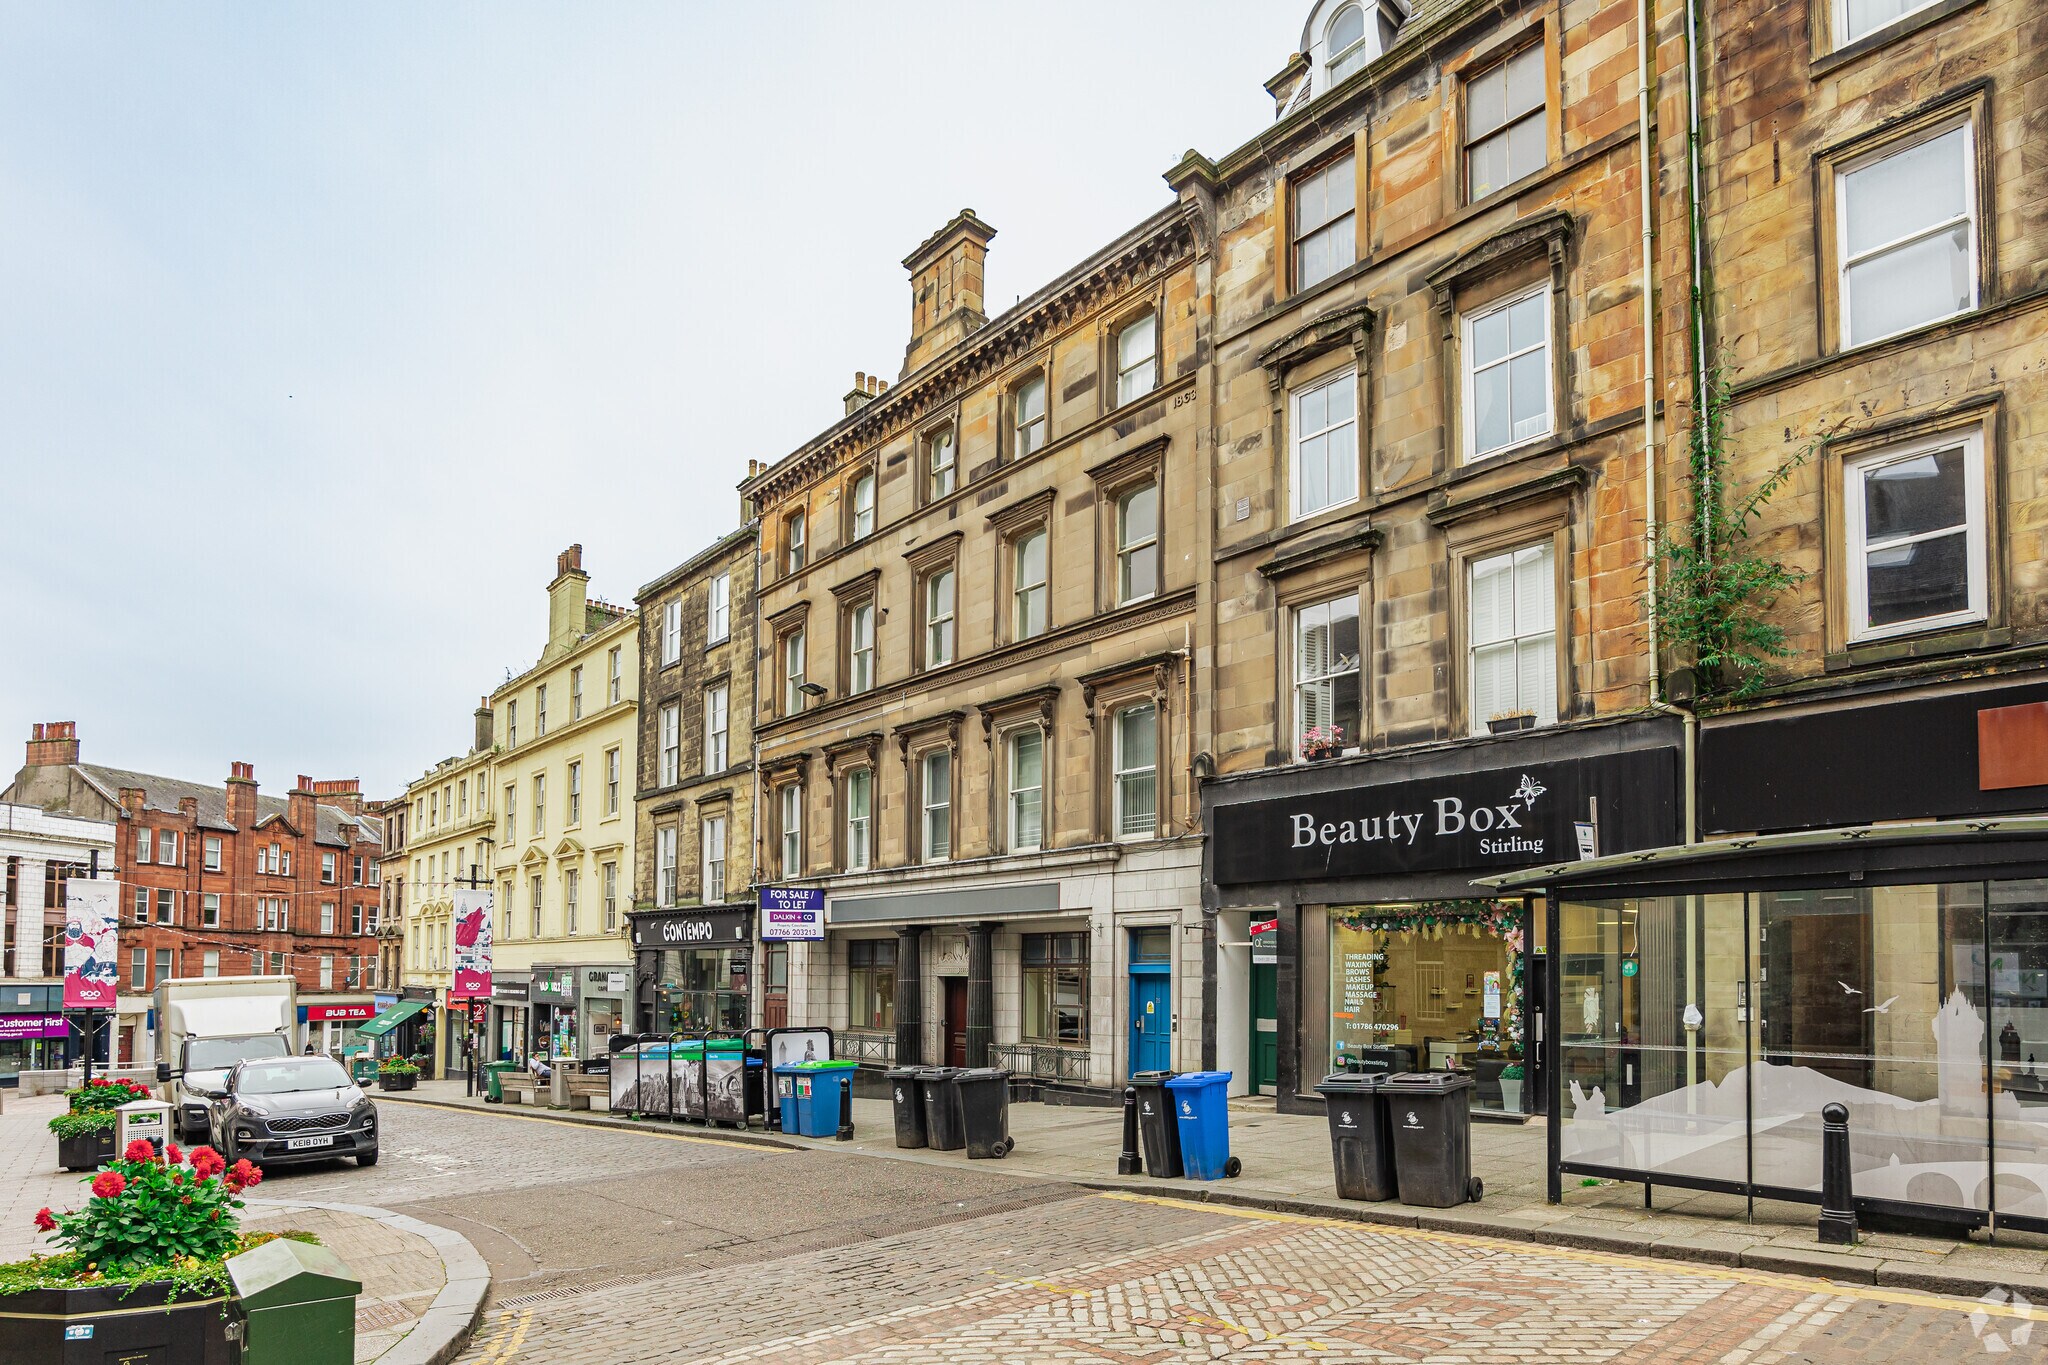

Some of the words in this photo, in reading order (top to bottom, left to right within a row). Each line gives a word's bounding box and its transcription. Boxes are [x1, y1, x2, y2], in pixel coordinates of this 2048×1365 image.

[1289, 810, 1424, 848] Beauty
[1433, 796, 1522, 835] Box
[1479, 836, 1544, 855] Stirling
[770, 890, 787, 899] FOR
[789, 890, 809, 899] SALE
[778, 900, 790, 909] TO
[793, 900, 806, 909] LET
[663, 921, 713, 941] CONTEMPO
[325, 1009, 346, 1017] BUB
[348, 1008, 367, 1016] TEA
[45, 1018, 63, 1026] First
[1373, 1023, 1399, 1031] 470296
[292, 1139, 311, 1147] KE18
[312, 1137, 329, 1145] OYH
